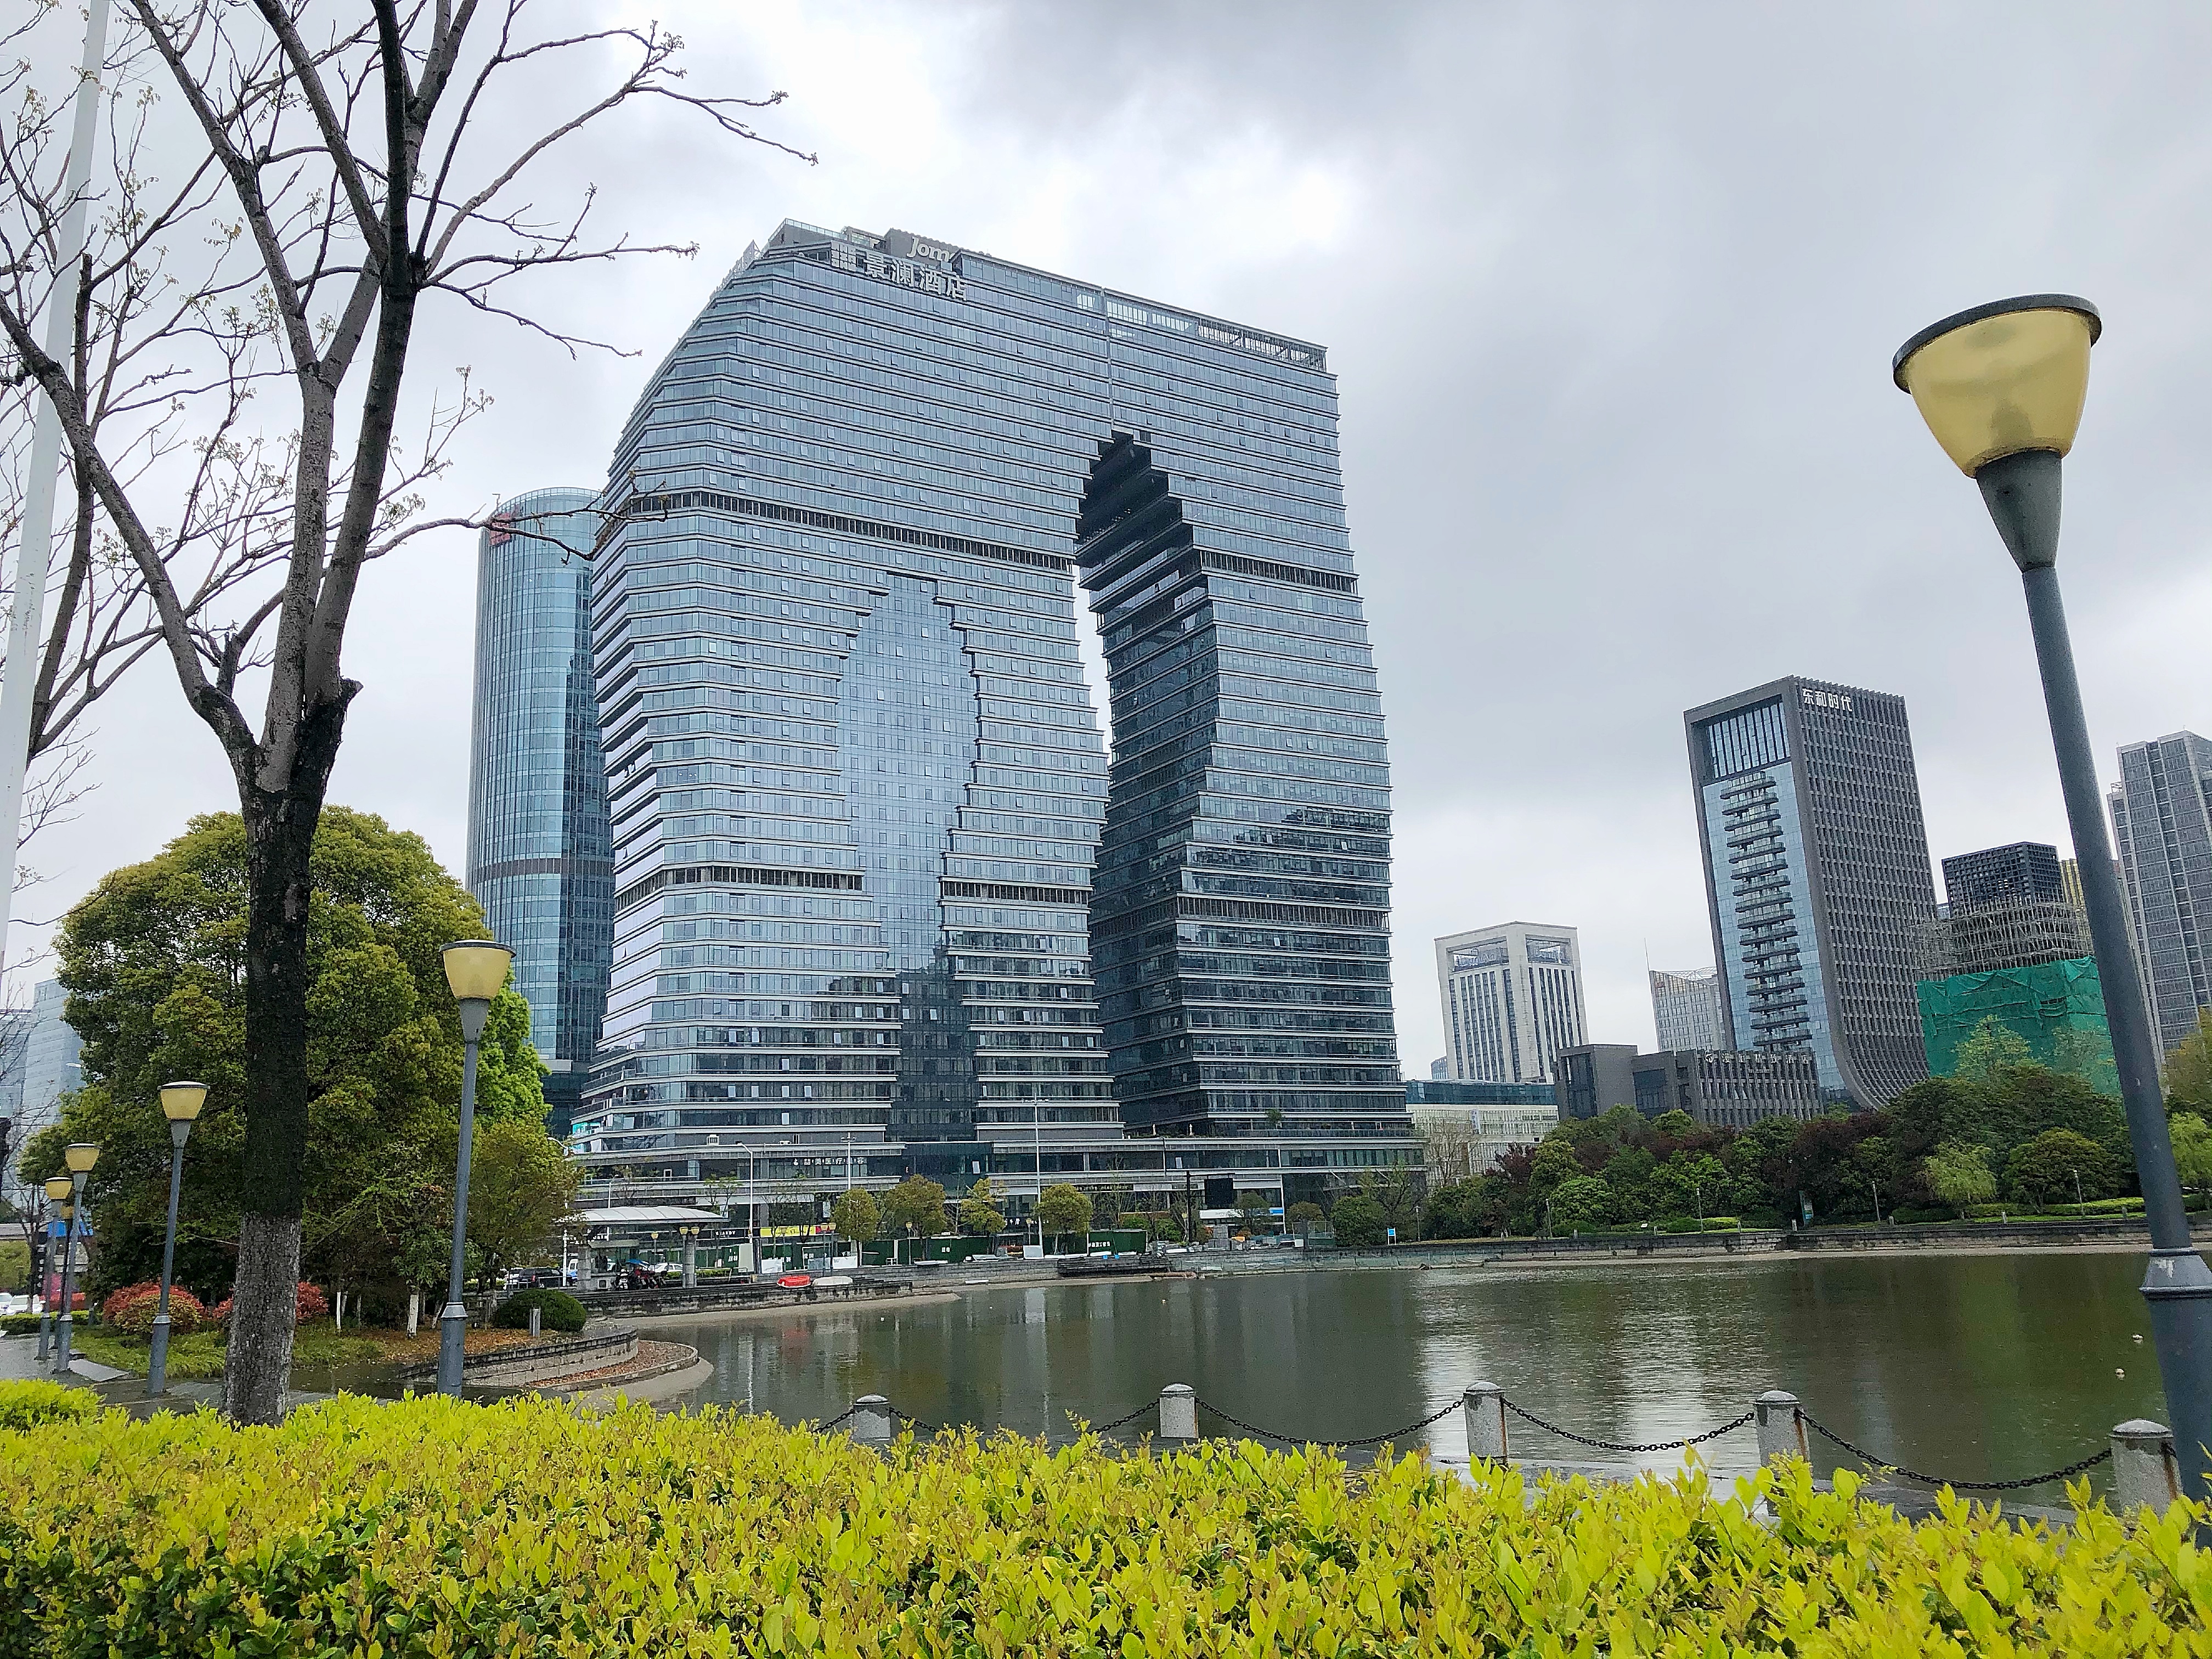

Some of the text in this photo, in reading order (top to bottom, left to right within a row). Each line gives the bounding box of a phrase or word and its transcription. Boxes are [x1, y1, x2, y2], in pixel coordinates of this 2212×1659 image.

[906, 236, 956, 263] Jom
[863, 250, 967, 301] 景澜酒店
